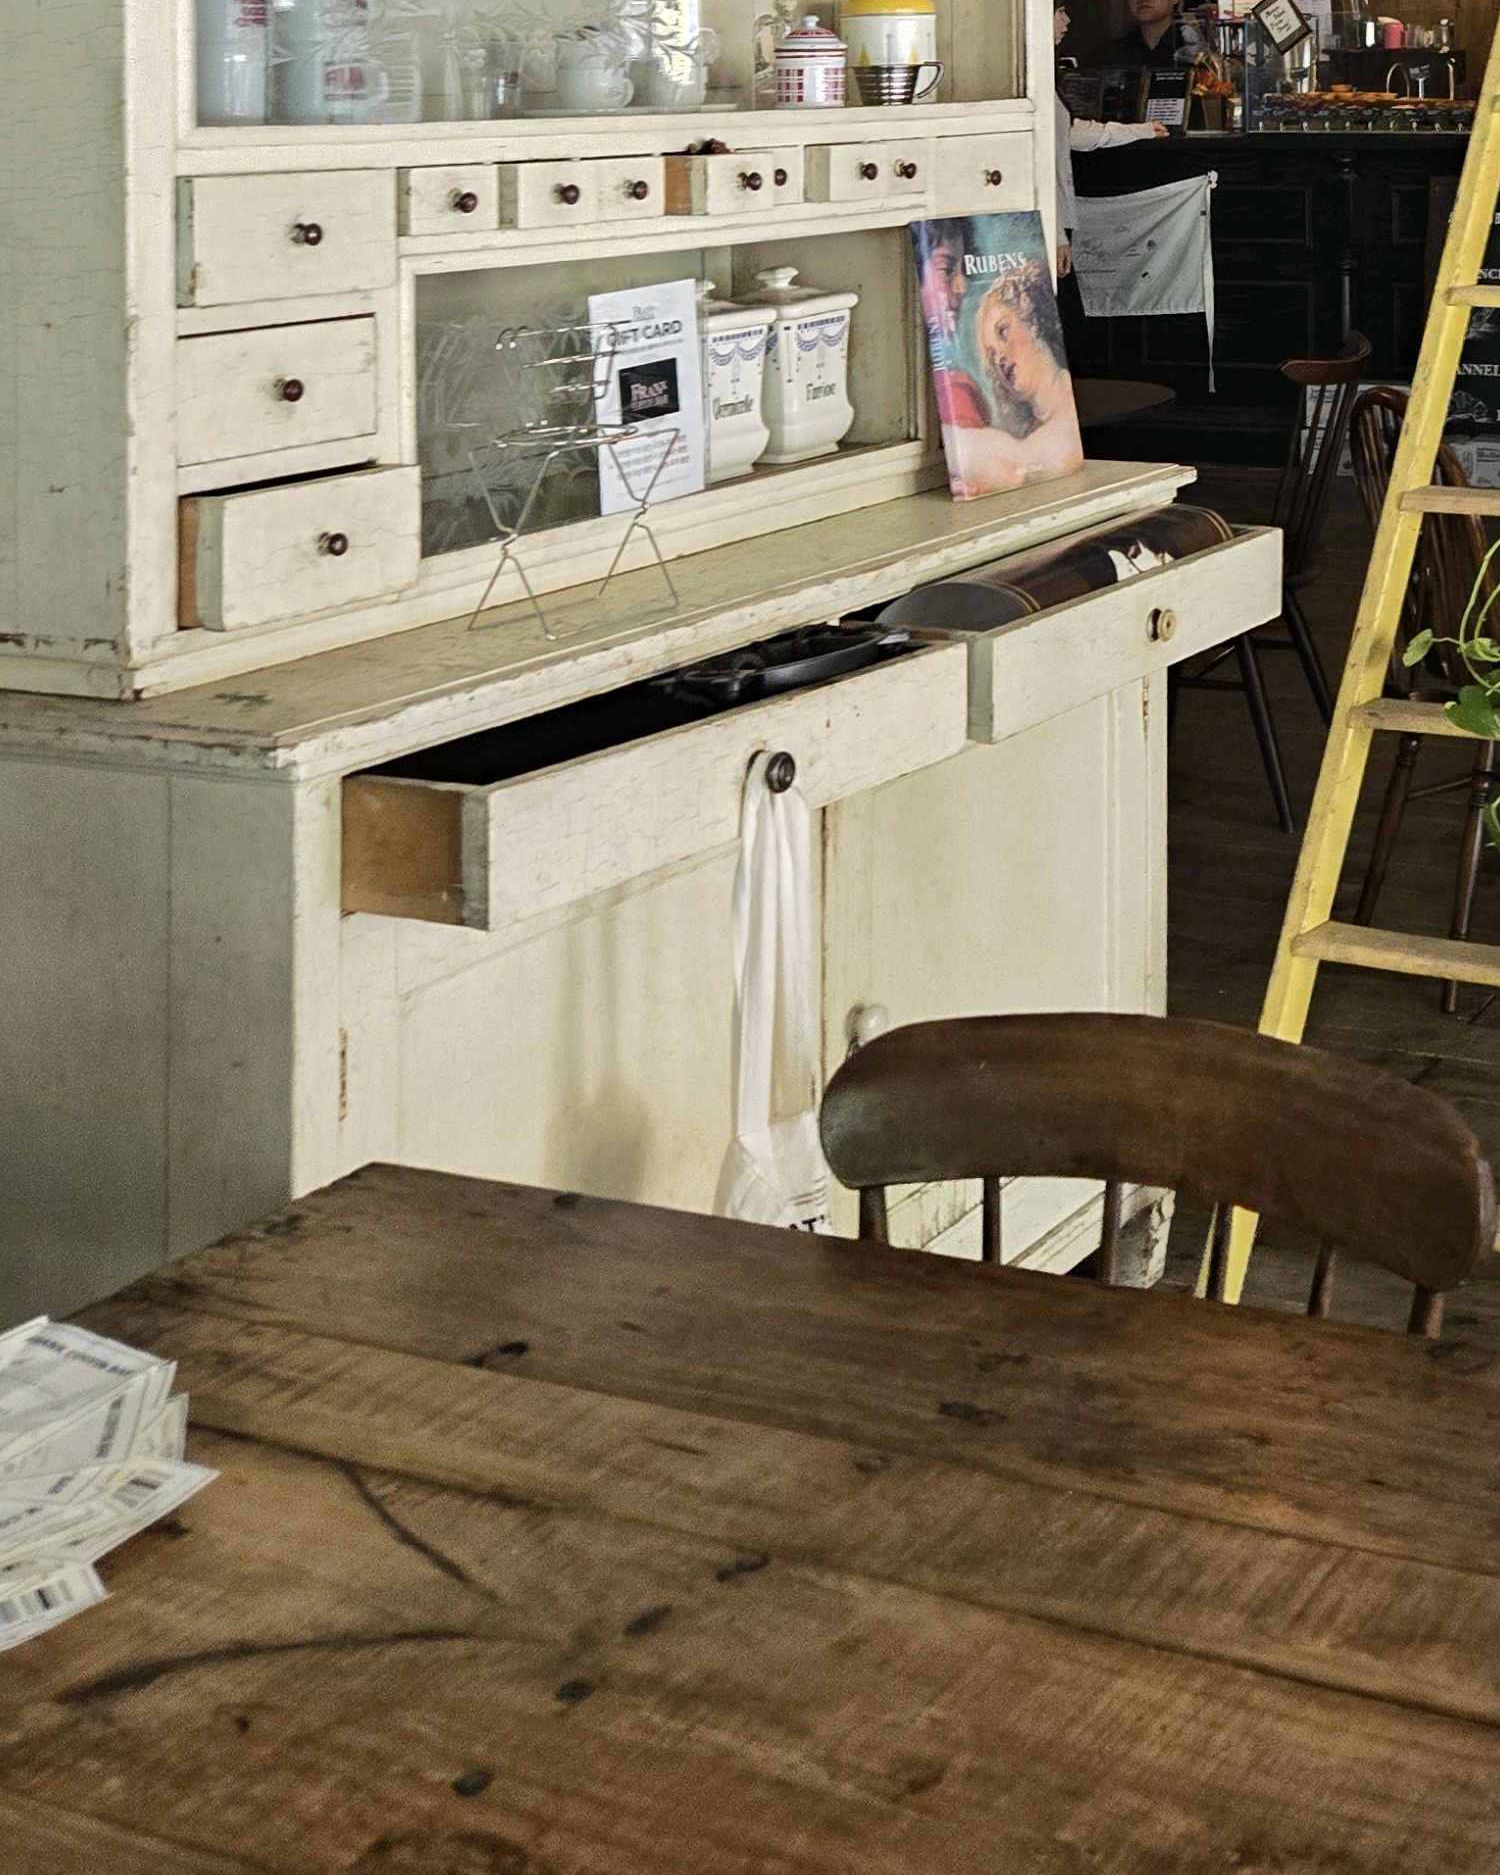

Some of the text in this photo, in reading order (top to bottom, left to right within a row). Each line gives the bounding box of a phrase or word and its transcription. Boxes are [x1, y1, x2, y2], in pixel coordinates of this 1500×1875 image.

[963, 251, 1030, 276] RUBENS
[607, 319, 683, 346] GIFT CARD
